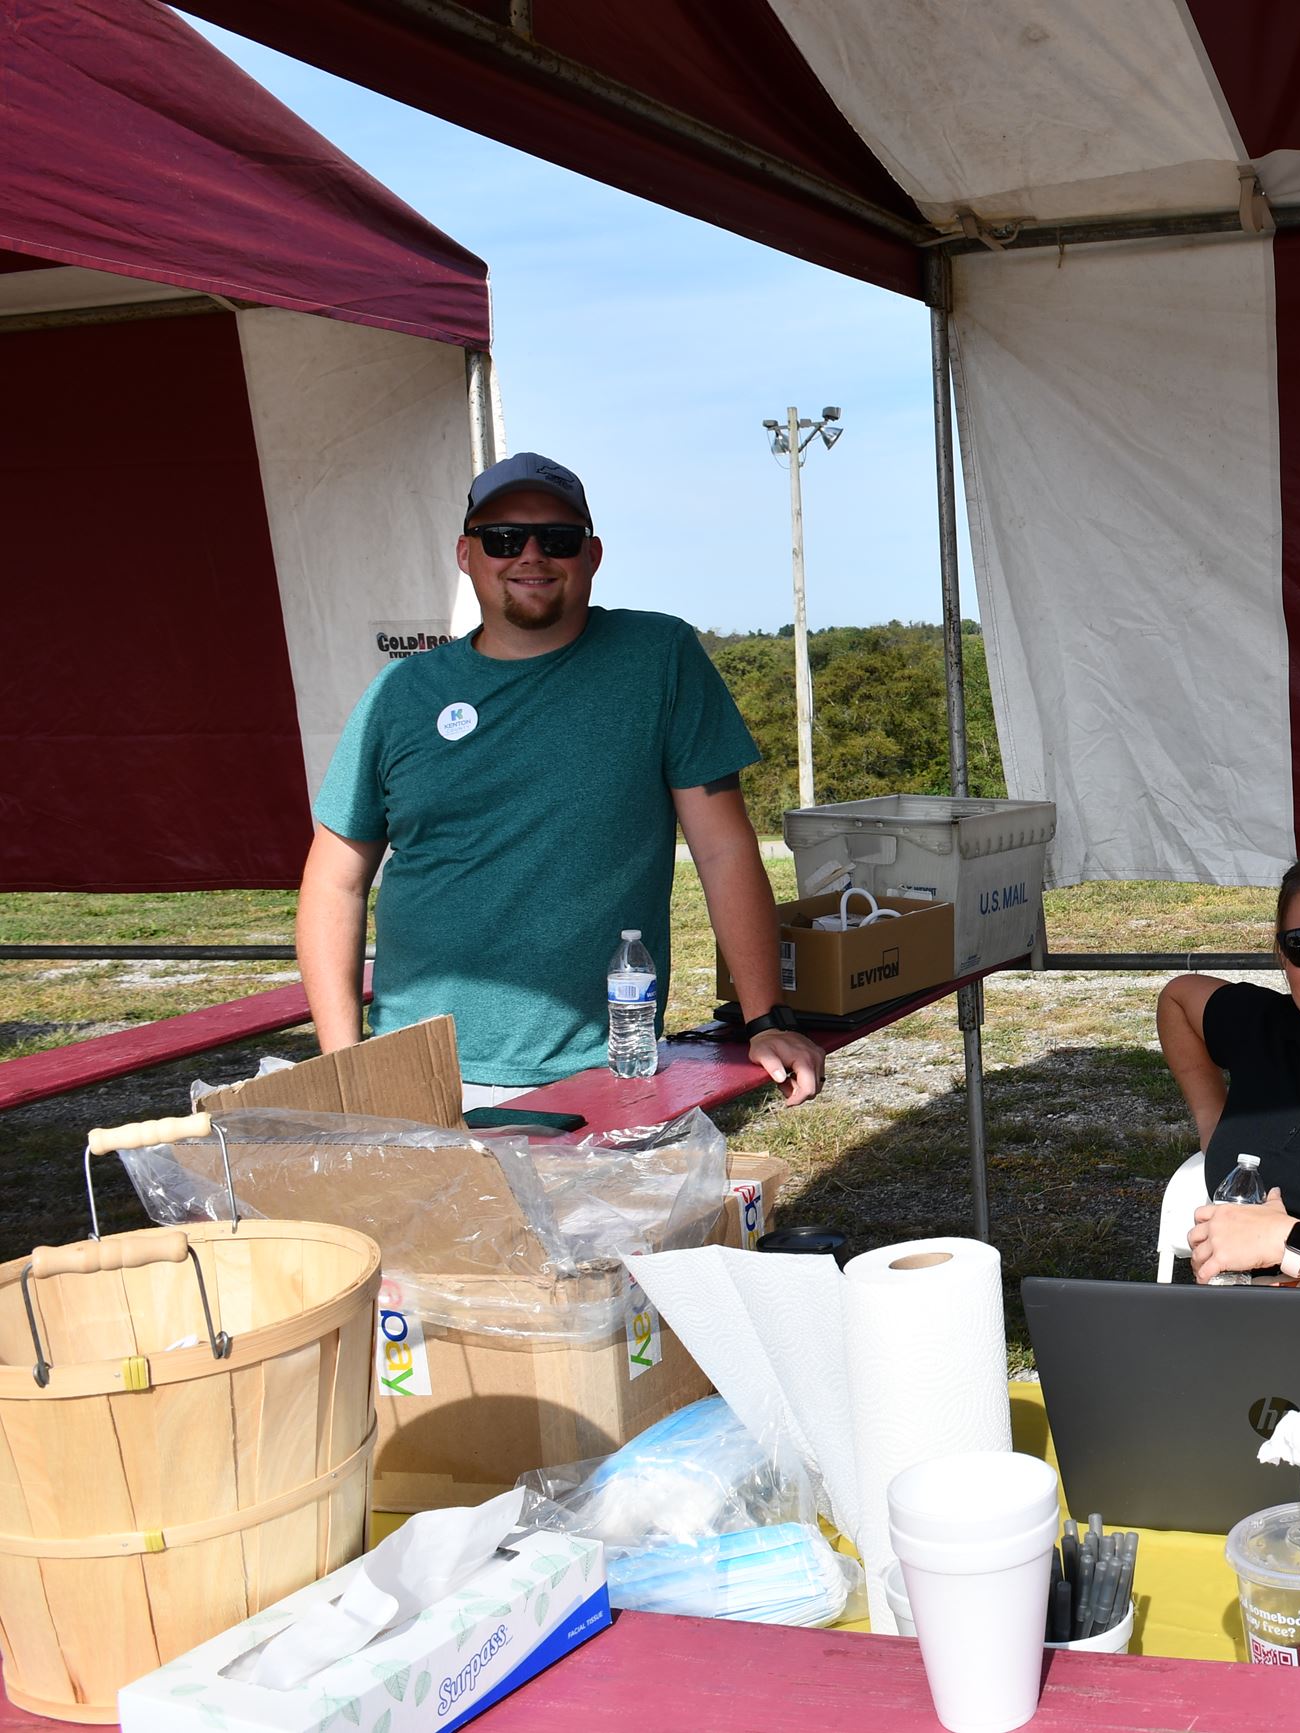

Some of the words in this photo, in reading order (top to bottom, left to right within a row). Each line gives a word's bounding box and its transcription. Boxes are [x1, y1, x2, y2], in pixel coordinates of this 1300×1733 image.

[444, 719, 472, 730] KENTON
[980, 890, 1001, 916] U.S.
[1002, 882, 1029, 909] MAIL
[850, 961, 900, 989] LEVITON
[567, 1624, 586, 1639] FACIAL
[586, 1610, 603, 1627] TISSUE
[1262, 1620, 1296, 1638] free?
[437, 1624, 507, 1716] Surpass
